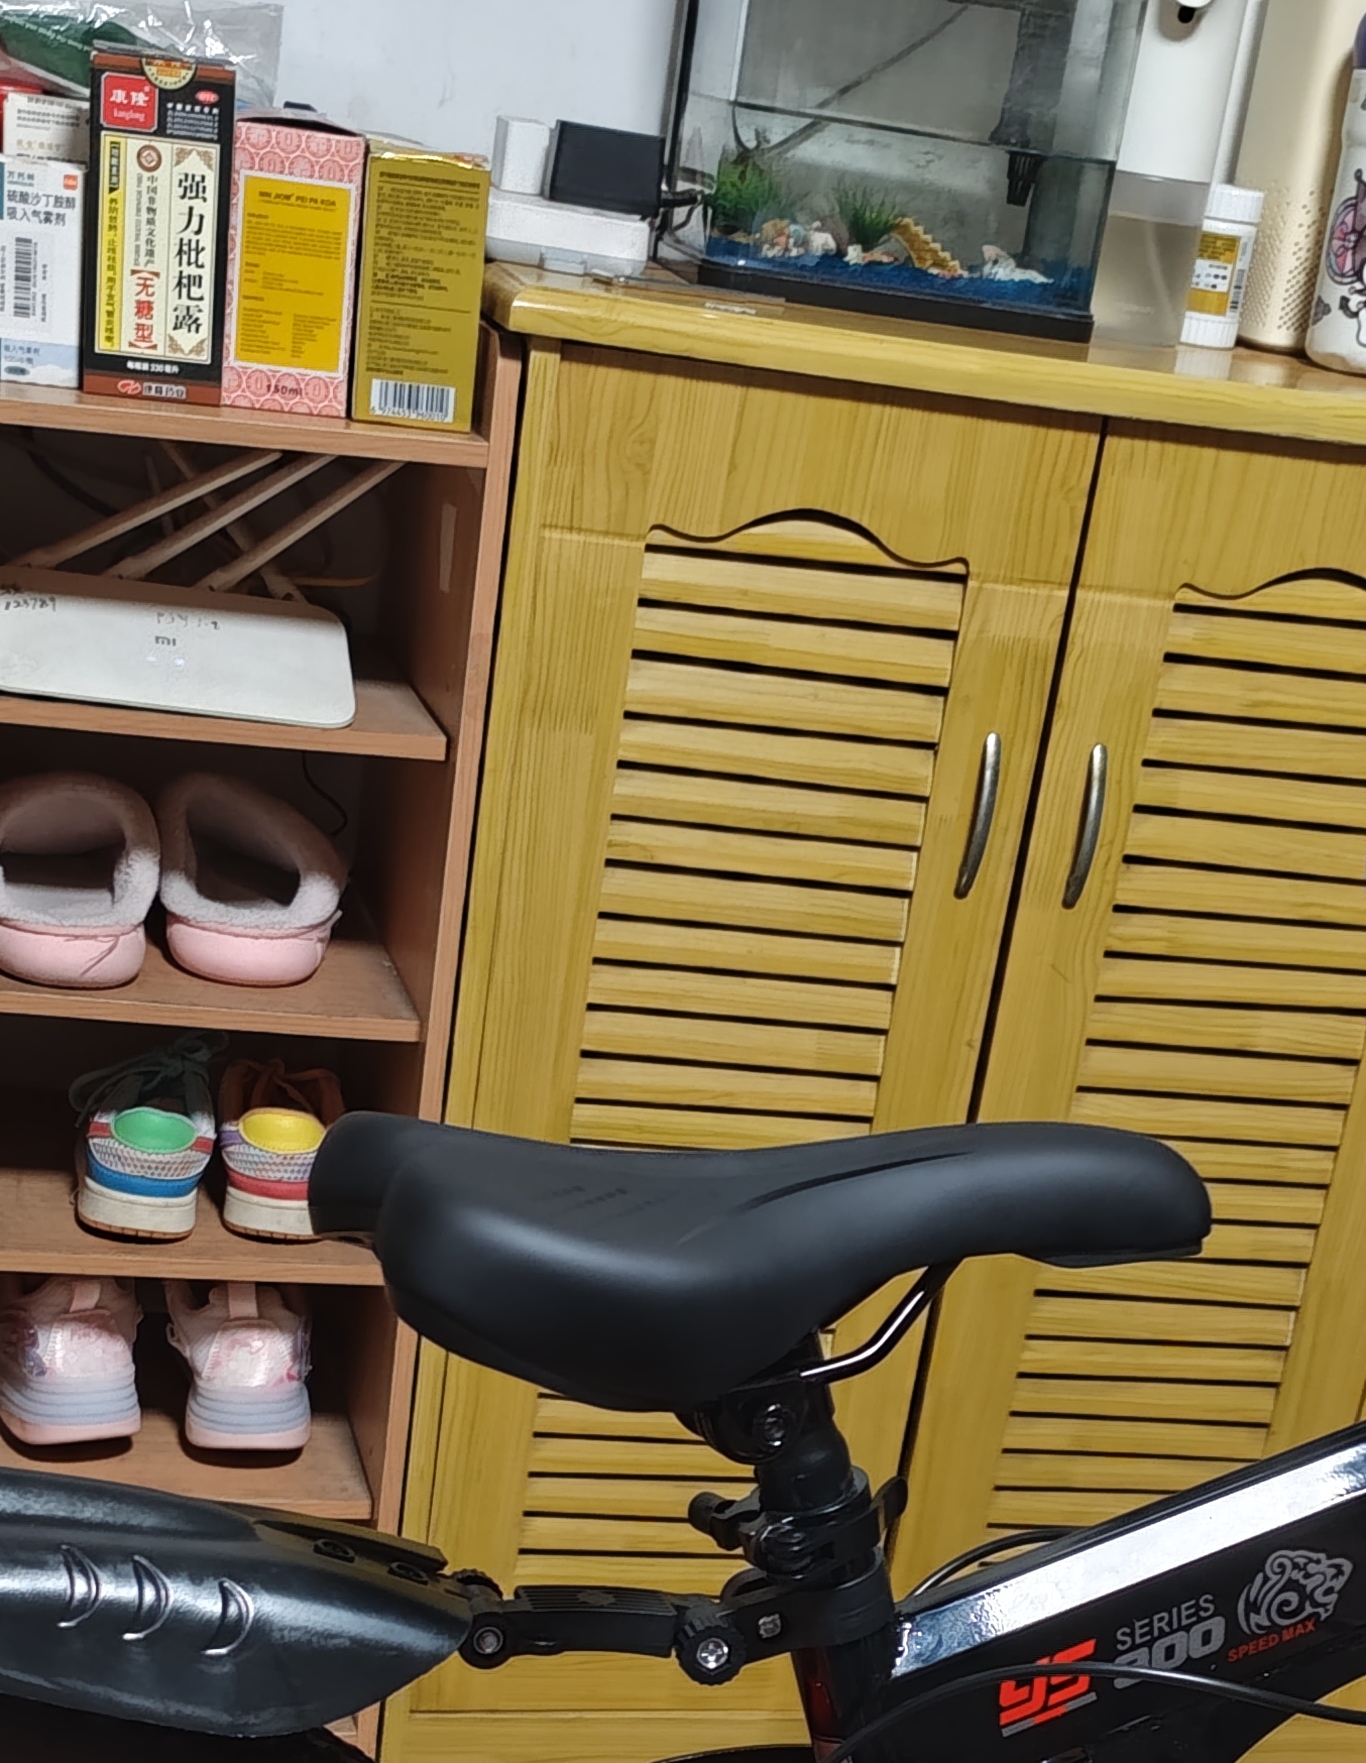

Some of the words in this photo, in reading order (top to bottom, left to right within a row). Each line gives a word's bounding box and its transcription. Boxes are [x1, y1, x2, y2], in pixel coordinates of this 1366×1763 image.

[7, 207, 66, 227] 吸入气雾剂
[172, 172, 208, 334] 强力枇杷露
[1116, 1594, 1215, 1650] SERIES
[1227, 1633, 1279, 1662] SPEED
[1281, 1618, 1316, 1642] MAX
